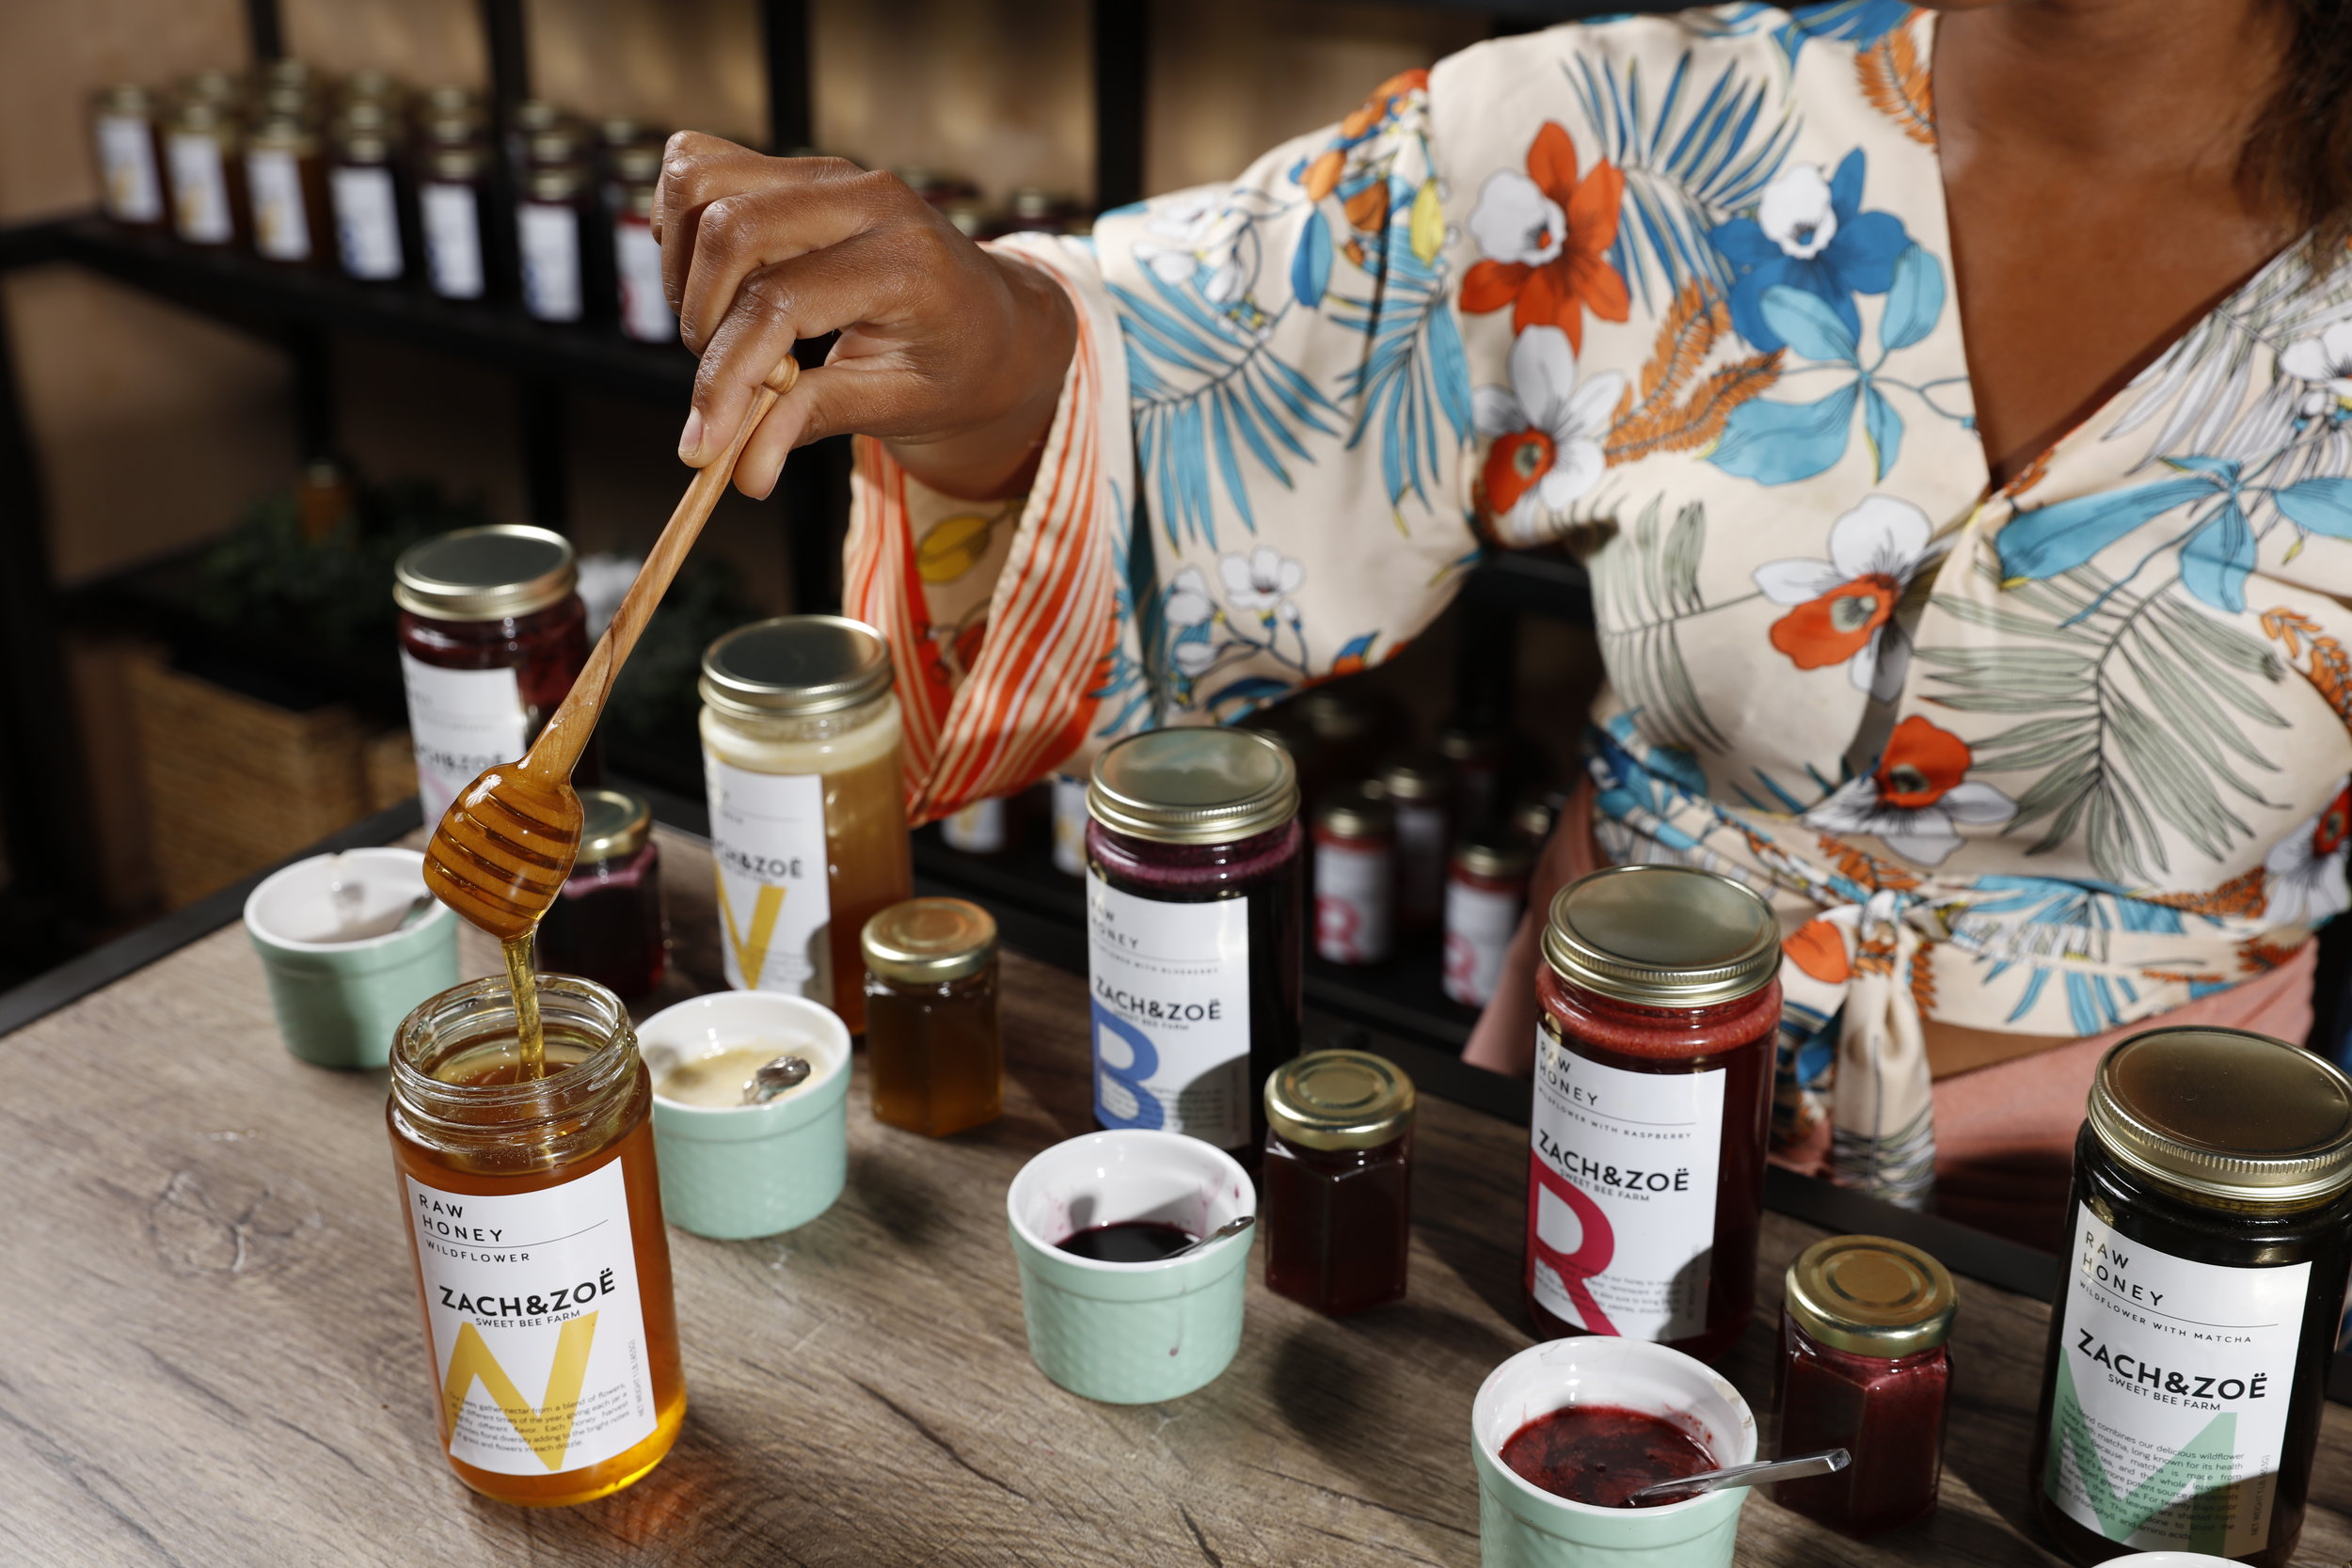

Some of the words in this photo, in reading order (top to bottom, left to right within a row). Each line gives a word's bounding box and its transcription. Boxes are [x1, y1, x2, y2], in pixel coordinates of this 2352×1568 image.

[1096, 975, 1221, 1022] ZACH&ZOË
[1539, 1060, 1598, 1106] HONEY
[1591, 1120, 1618, 1133] WITH
[1623, 1129, 1692, 1140] RASPBERRY
[1538, 1128, 1691, 1192] ZACH&ZOË
[1560, 1168, 1591, 1190] SWEET
[1594, 1183, 1614, 1197] BEE
[1617, 1189, 1650, 1202] FARM
[419, 1194, 463, 1219] RAW
[422, 1214, 502, 1243] HONEY
[425, 1239, 531, 1263] WILDFLOWER
[2085, 1230, 2129, 1270] RAW
[438, 1267, 615, 1318] ZACH&ZOË
[2083, 1252, 2164, 1307] HONEY
[475, 1317, 515, 1328] SWEET
[518, 1318, 543, 1328] BEE
[547, 1309, 581, 1324] FARM
[2079, 1280, 2147, 1324] WILDFLOWER
[2153, 1322, 2186, 1337] WITH
[2194, 1332, 2252, 1343] MATCHA
[2076, 1327, 2268, 1401] ZACH&ZOË
[532, 1406, 552, 1415] from
[563, 1399, 585, 1410] blend
[2107, 1373, 2150, 1397] SWEET
[2153, 1392, 2178, 1405] BEE
[2183, 1399, 2221, 1411] FARM
[533, 1434, 562, 1444] adding
[572, 1429, 586, 1438] the
[545, 1423, 565, 1433] Each
[2097, 1421, 2137, 1444] combines
[2138, 1440, 2154, 1449] our
[2156, 1445, 2197, 1459] delicious
[2200, 1452, 2245, 1461] wildflower
[533, 1445, 555, 1453] each
[2090, 1439, 2123, 1460] Because
[2130, 1459, 2164, 1473] matcha
[2097, 1432, 2129, 1453] matcha,
[2131, 1447, 2152, 1462] long
[2153, 1454, 2184, 1467] known
[2186, 1461, 2200, 1469] for
[2103, 1468, 2126, 1482] more
[2126, 1479, 2155, 1493] potent
[2156, 1487, 2187, 1499] source
[2119, 1465, 2136, 1476] and
[2140, 1472, 2154, 1481] the
[2159, 1478, 2186, 1489] whole
[2100, 1478, 2123, 1493] green
[2125, 1488, 2140, 1498] tea.
[2143, 1493, 2158, 1503] For
[2161, 1498, 2191, 1511] twenty
[2126, 1498, 2153, 1513] leaves
[2110, 1502, 2127, 1514] This
[2174, 1520, 2184, 1528] to
[2119, 1518, 2137, 1528] and
[2139, 1525, 2167, 1536] amino
